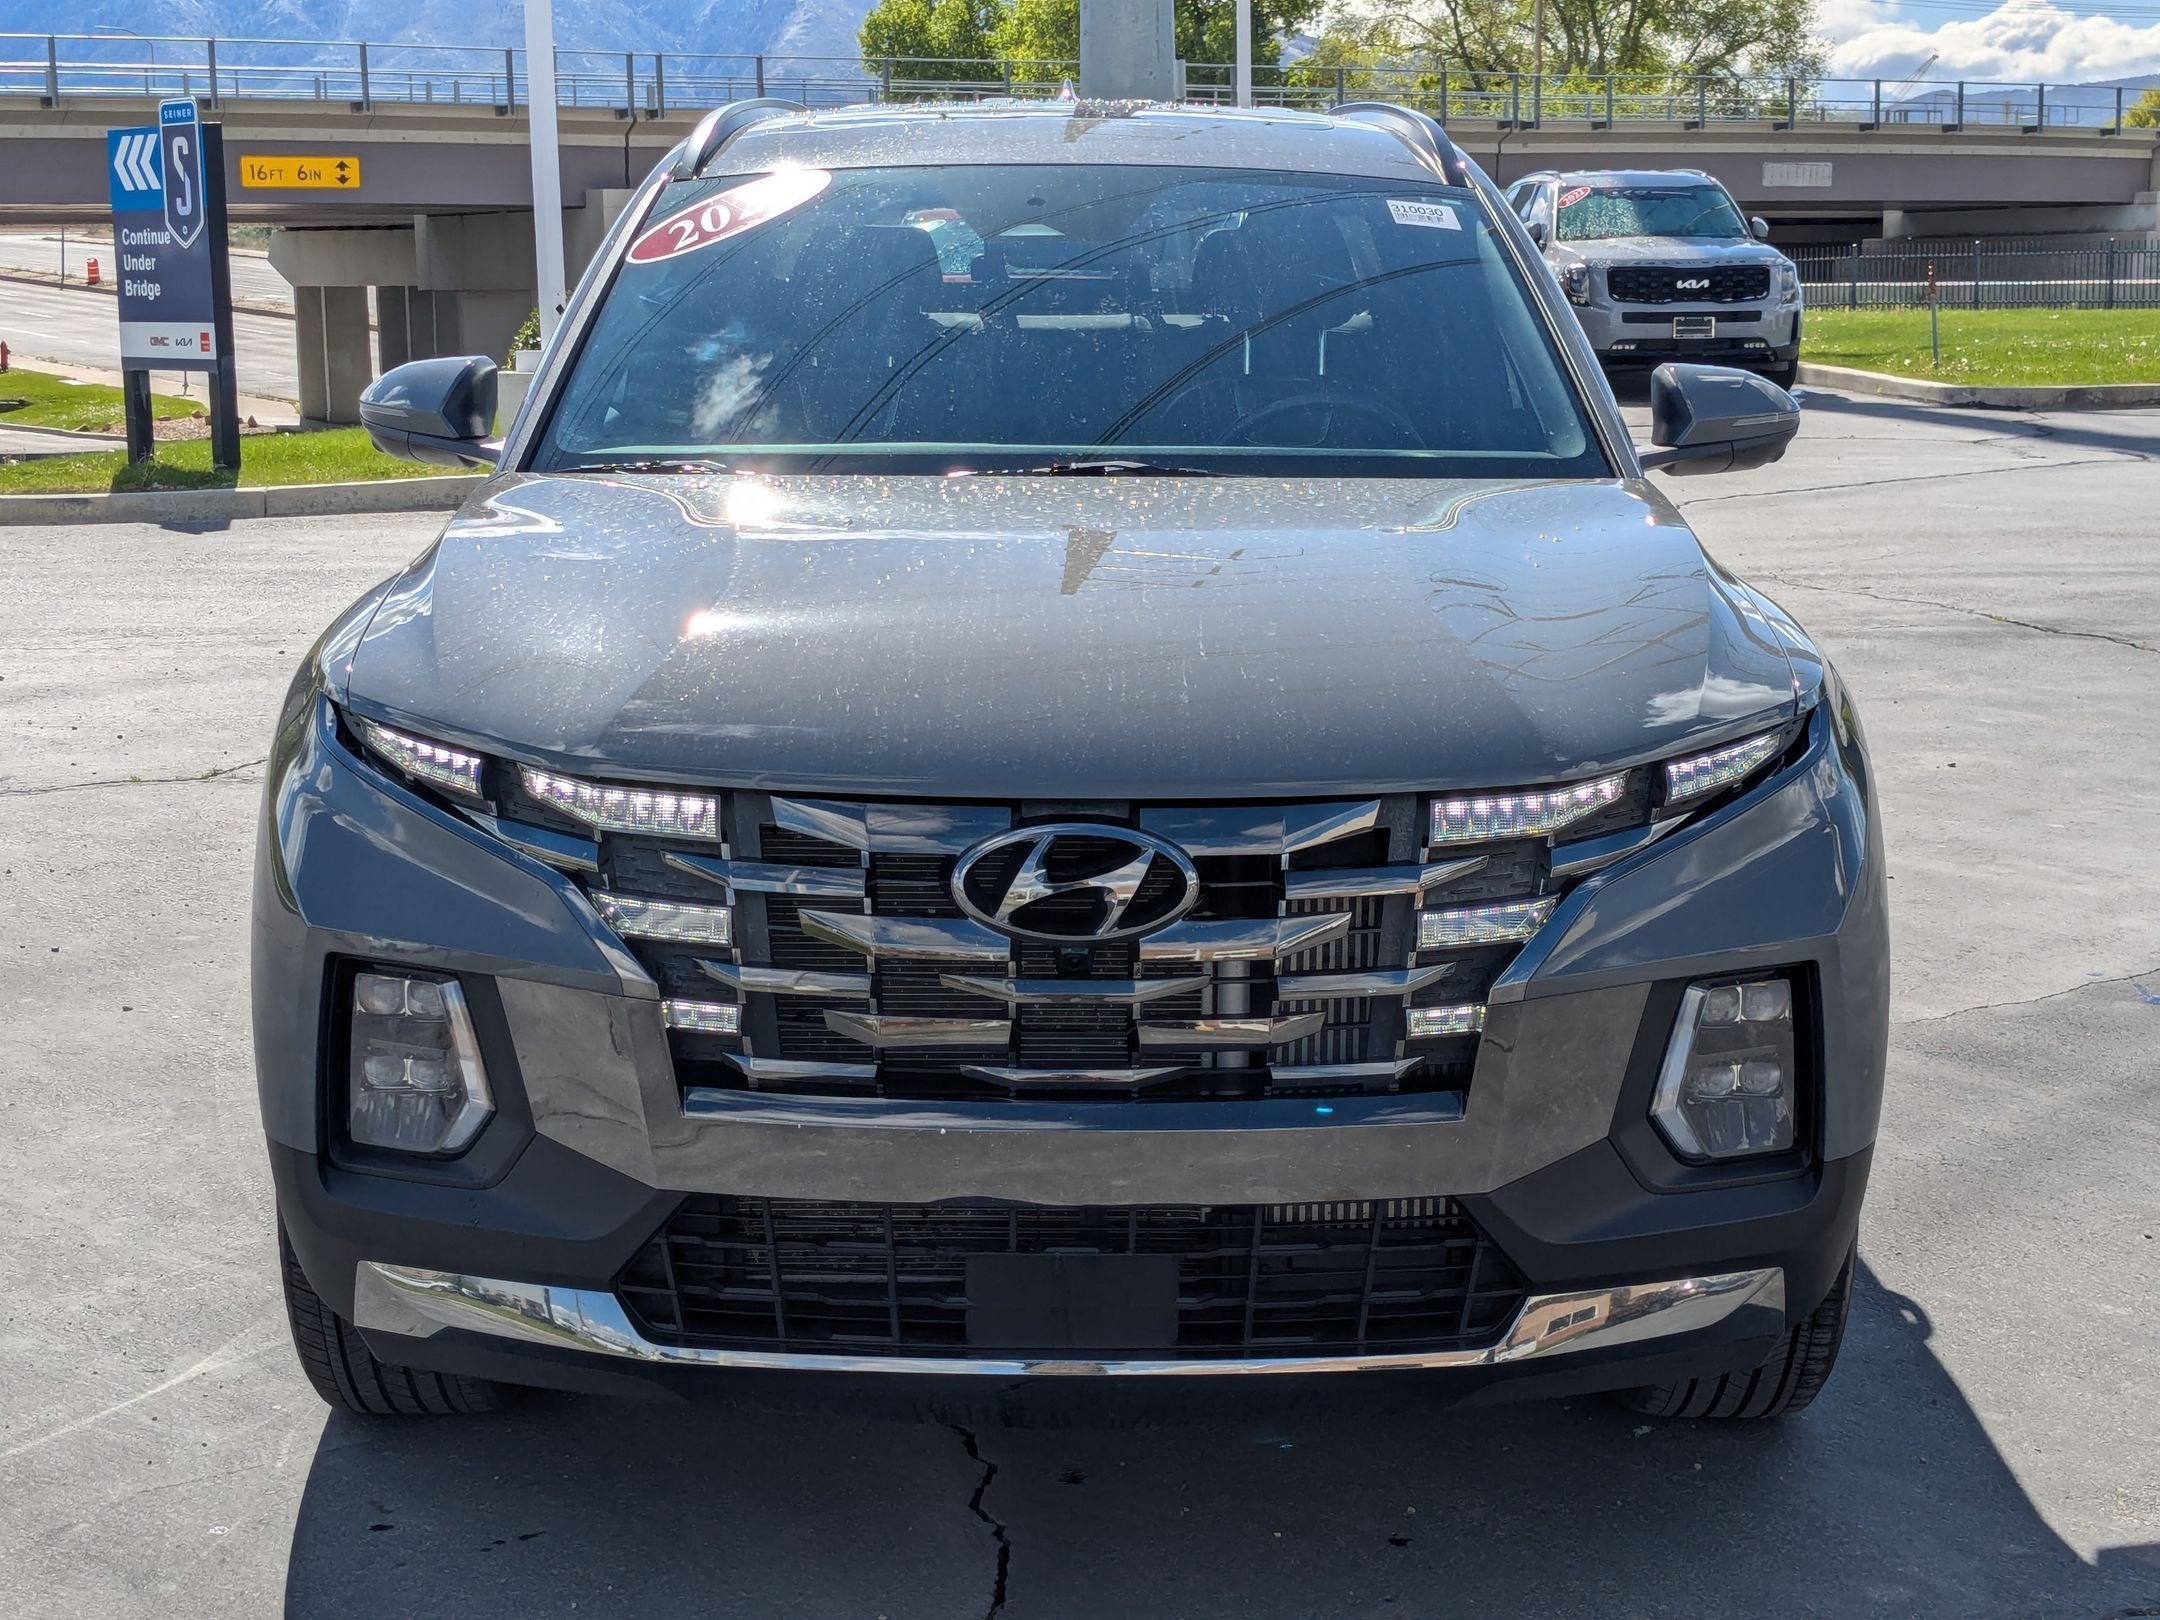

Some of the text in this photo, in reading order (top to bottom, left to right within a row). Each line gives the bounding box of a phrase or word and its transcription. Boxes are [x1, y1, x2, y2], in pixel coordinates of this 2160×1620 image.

[163, 108, 192, 119] SEINER
[297, 164, 322, 181] 6IN
[1391, 204, 1444, 217] 310030
[122, 228, 171, 245] Continue
[123, 254, 156, 271] Under
[125, 279, 161, 301] Bridge
[1676, 279, 1710, 289] KIA
